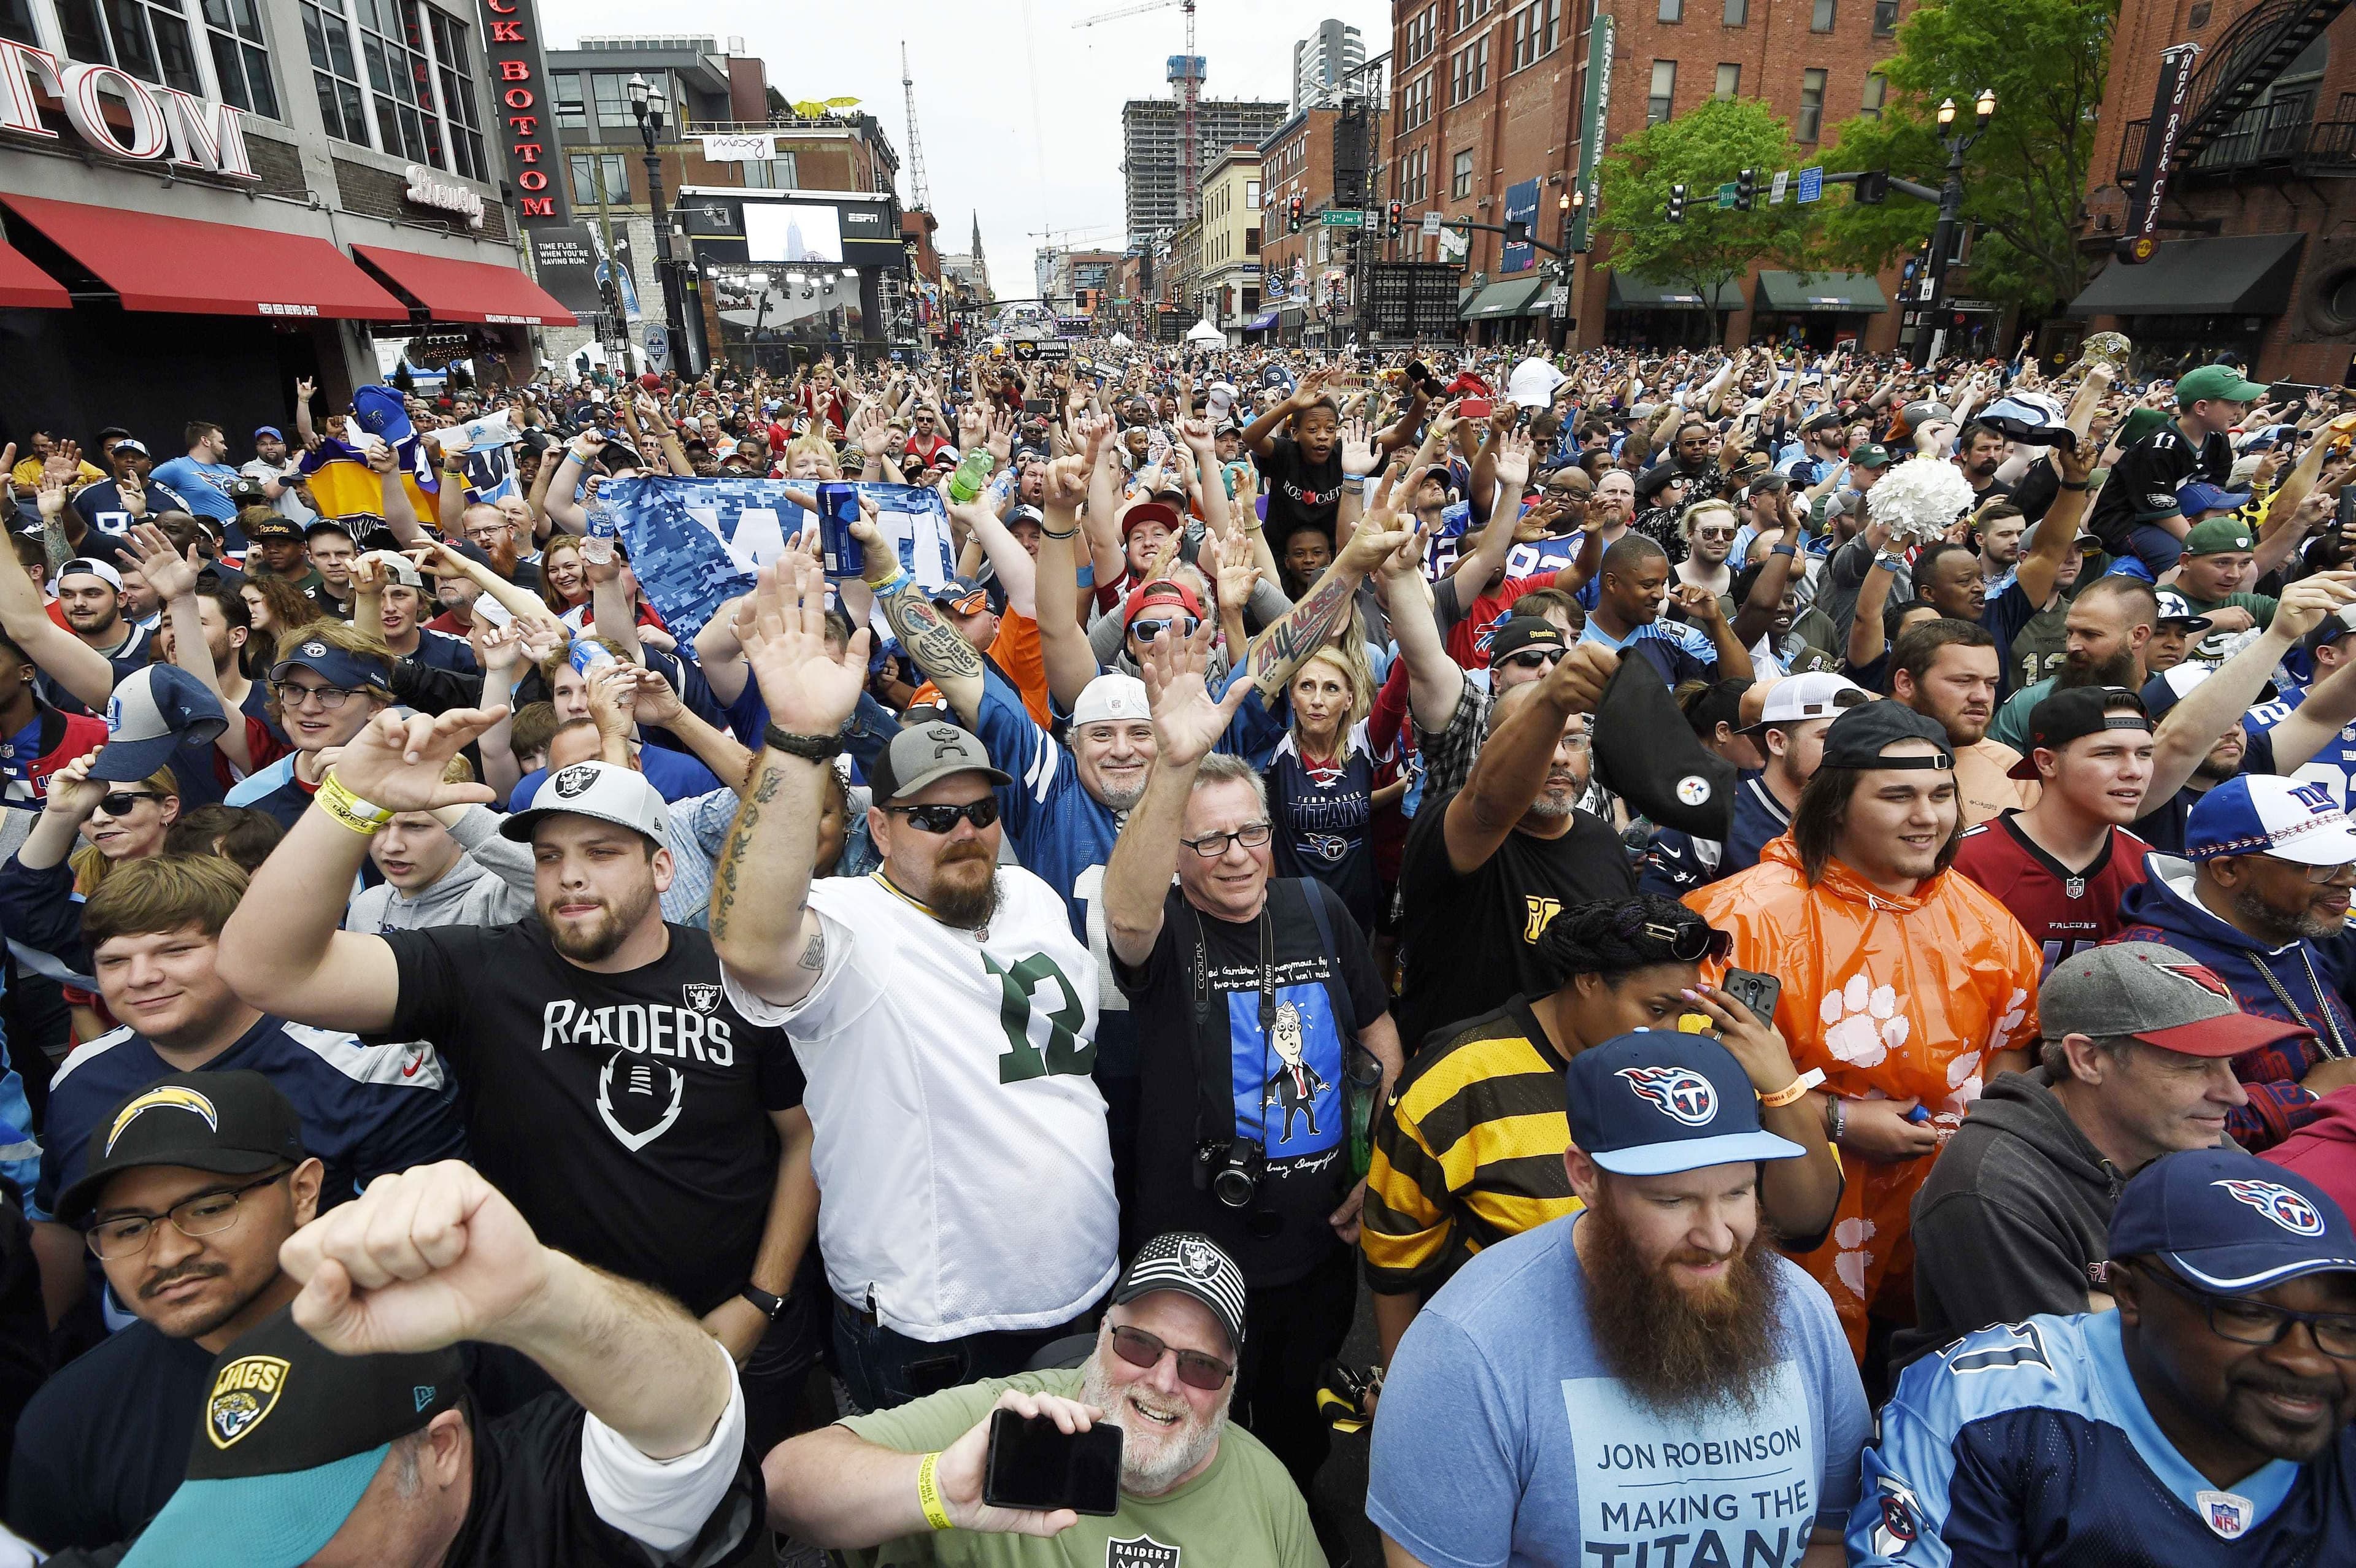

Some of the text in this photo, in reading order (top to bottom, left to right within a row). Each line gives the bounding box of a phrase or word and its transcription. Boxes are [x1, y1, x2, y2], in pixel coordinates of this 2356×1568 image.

[2174, 53, 2193, 105] Hard
[499, 61, 555, 216] BOTTOM
[713, 137, 765, 159] moxy
[2158, 113, 2179, 172] Rock
[406, 165, 485, 229] Brewery
[2144, 179, 2165, 233] Cafe
[848, 212, 879, 223] ESPN
[1037, 342, 1068, 350] #DUUUVAL
[1094, 361, 1125, 378] #DUUUVAL
[2152, 431, 2177, 450] 11
[259, 525, 290, 534] Packers
[928, 631, 946, 647] Motor
[1530, 628, 1557, 639] Steelers
[933, 625, 977, 668] Bristol
[1297, 791, 1361, 804] TENNSSEE
[2069, 886, 2082, 895] NFL
[1195, 942, 1204, 990] COOLPIX
[1274, 959, 1317, 972] nonymous...
[1318, 956, 1328, 968] they
[1263, 964, 1272, 996] Nikon
[1315, 970, 1331, 980] make
[981, 951, 1098, 1085] 12
[541, 999, 734, 1067] RAIDERS
[1185, 1242, 1218, 1262] RAIDERS
[217, 1362, 280, 1394] JAGS
[1597, 1425, 1801, 1470] JON ROBINSON
[920, 1485, 928, 1505] AREA
[1601, 1479, 1809, 1532] MAKING THE
[2214, 1515, 2241, 1532] NFL
[1585, 1515, 1815, 1568] TITANS
[1115, 1544, 1171, 1561] RAIDERS
